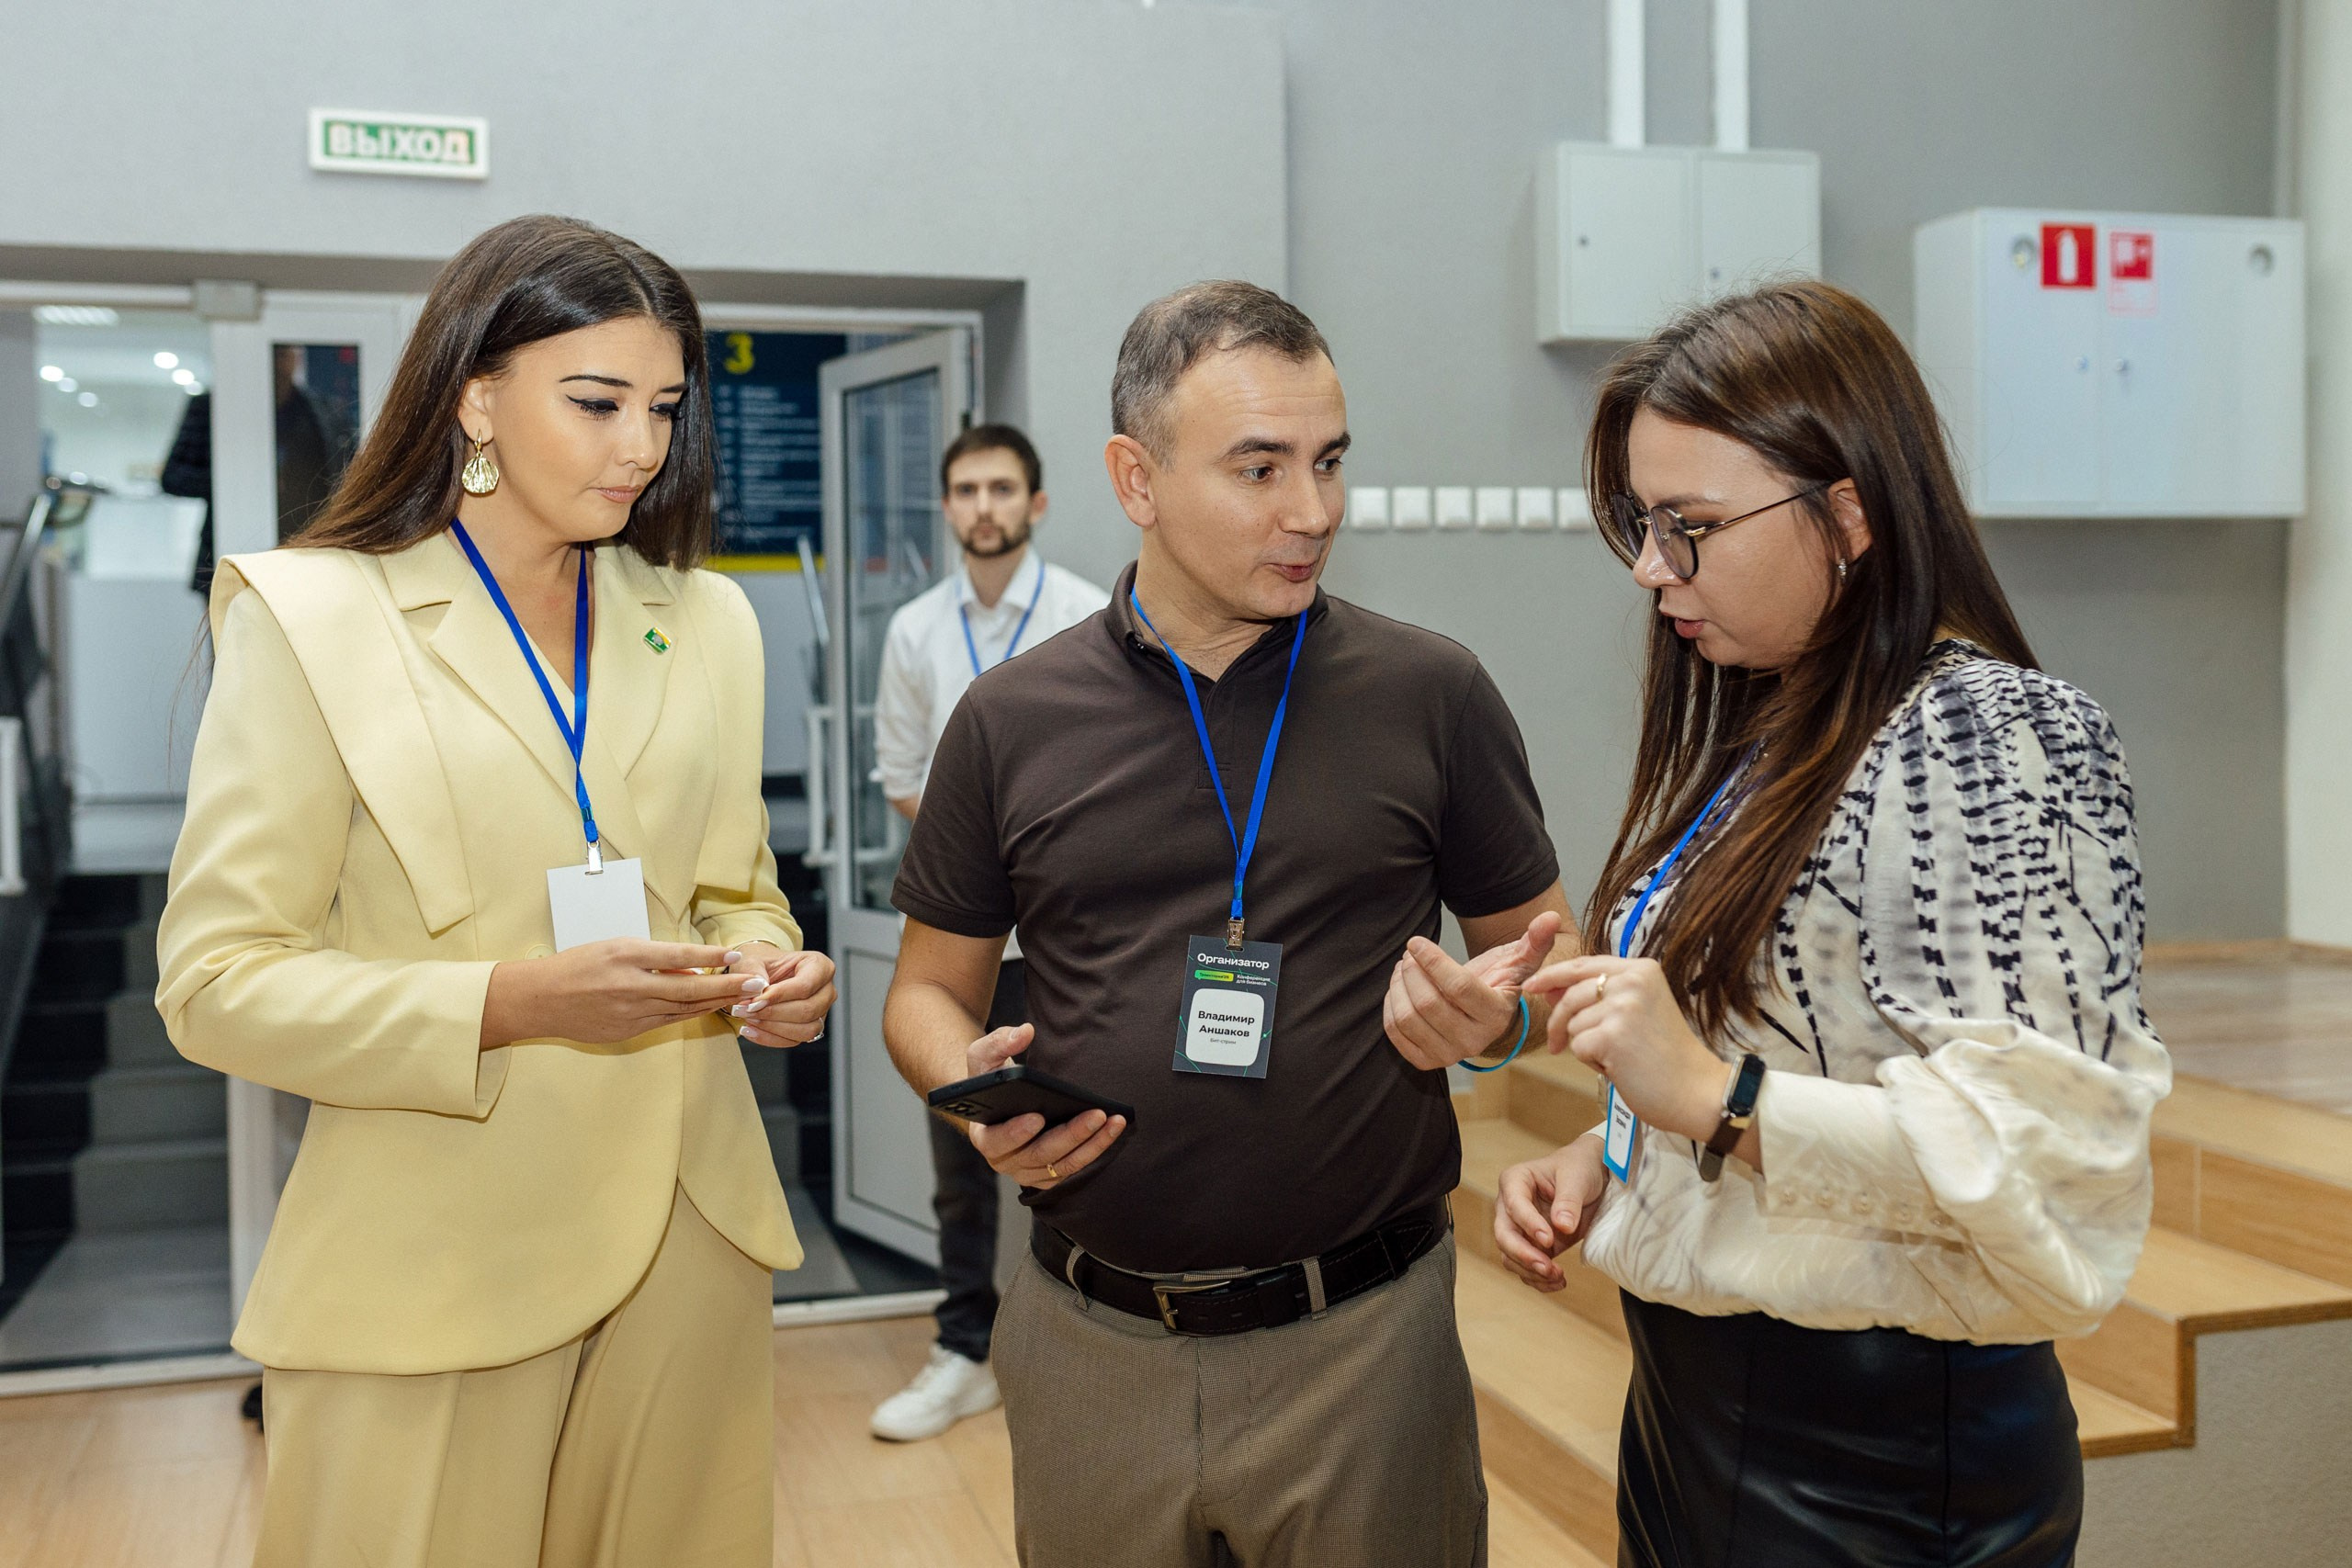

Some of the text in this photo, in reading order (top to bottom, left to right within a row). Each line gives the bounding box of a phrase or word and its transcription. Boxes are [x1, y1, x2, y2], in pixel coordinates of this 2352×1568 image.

[328, 122, 471, 163] ВЫХОД
[723, 332, 756, 375] 3
[1197, 953, 1270, 970] Организатор
[1198, 1010, 1255, 1025] Владимир
[1199, 1025, 1250, 1037] Аншаков
